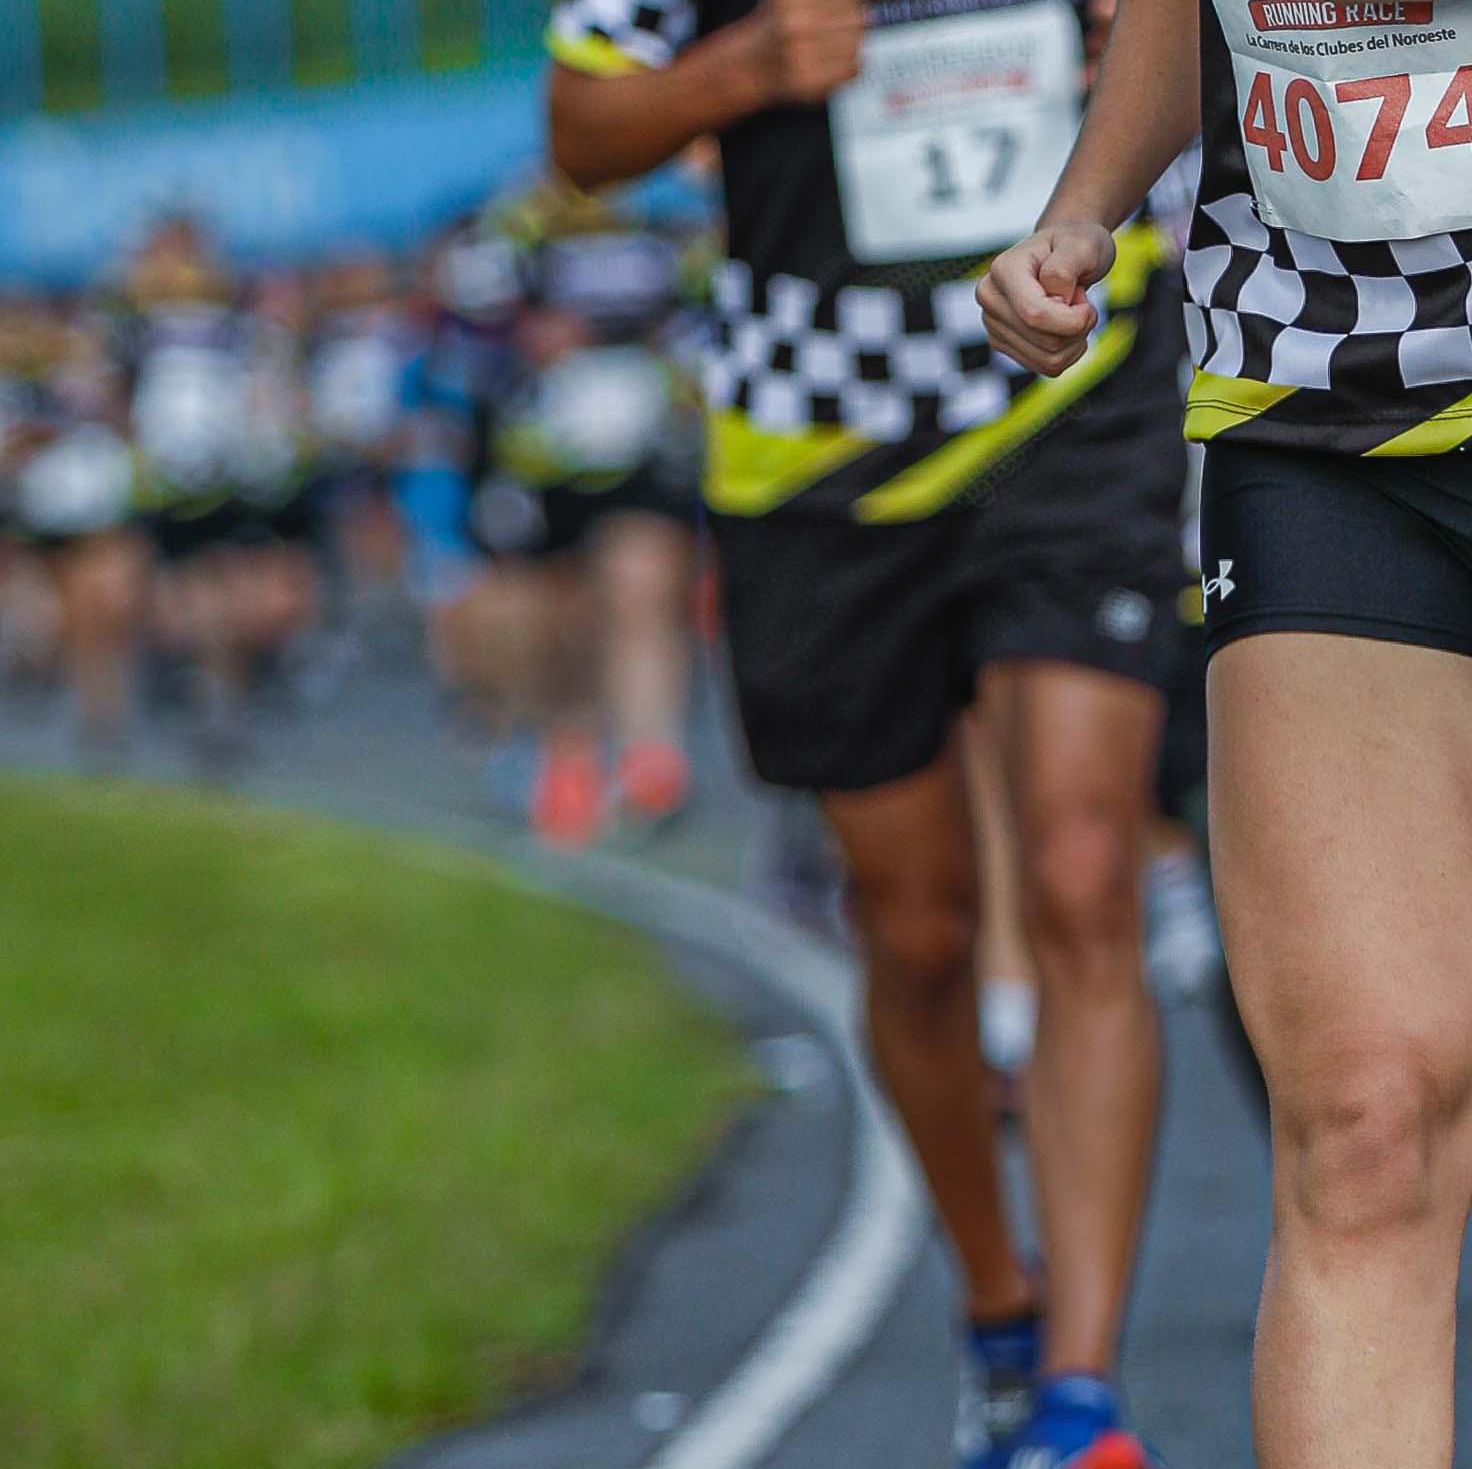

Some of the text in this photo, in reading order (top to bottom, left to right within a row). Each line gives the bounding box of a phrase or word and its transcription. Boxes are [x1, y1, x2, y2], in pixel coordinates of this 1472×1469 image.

[1262, 1, 1406, 27] RUNNING RACE
[1245, 28, 1457, 56] La Carrera de los Clubes del Noroeste
[923, 129, 1020, 206] 17
